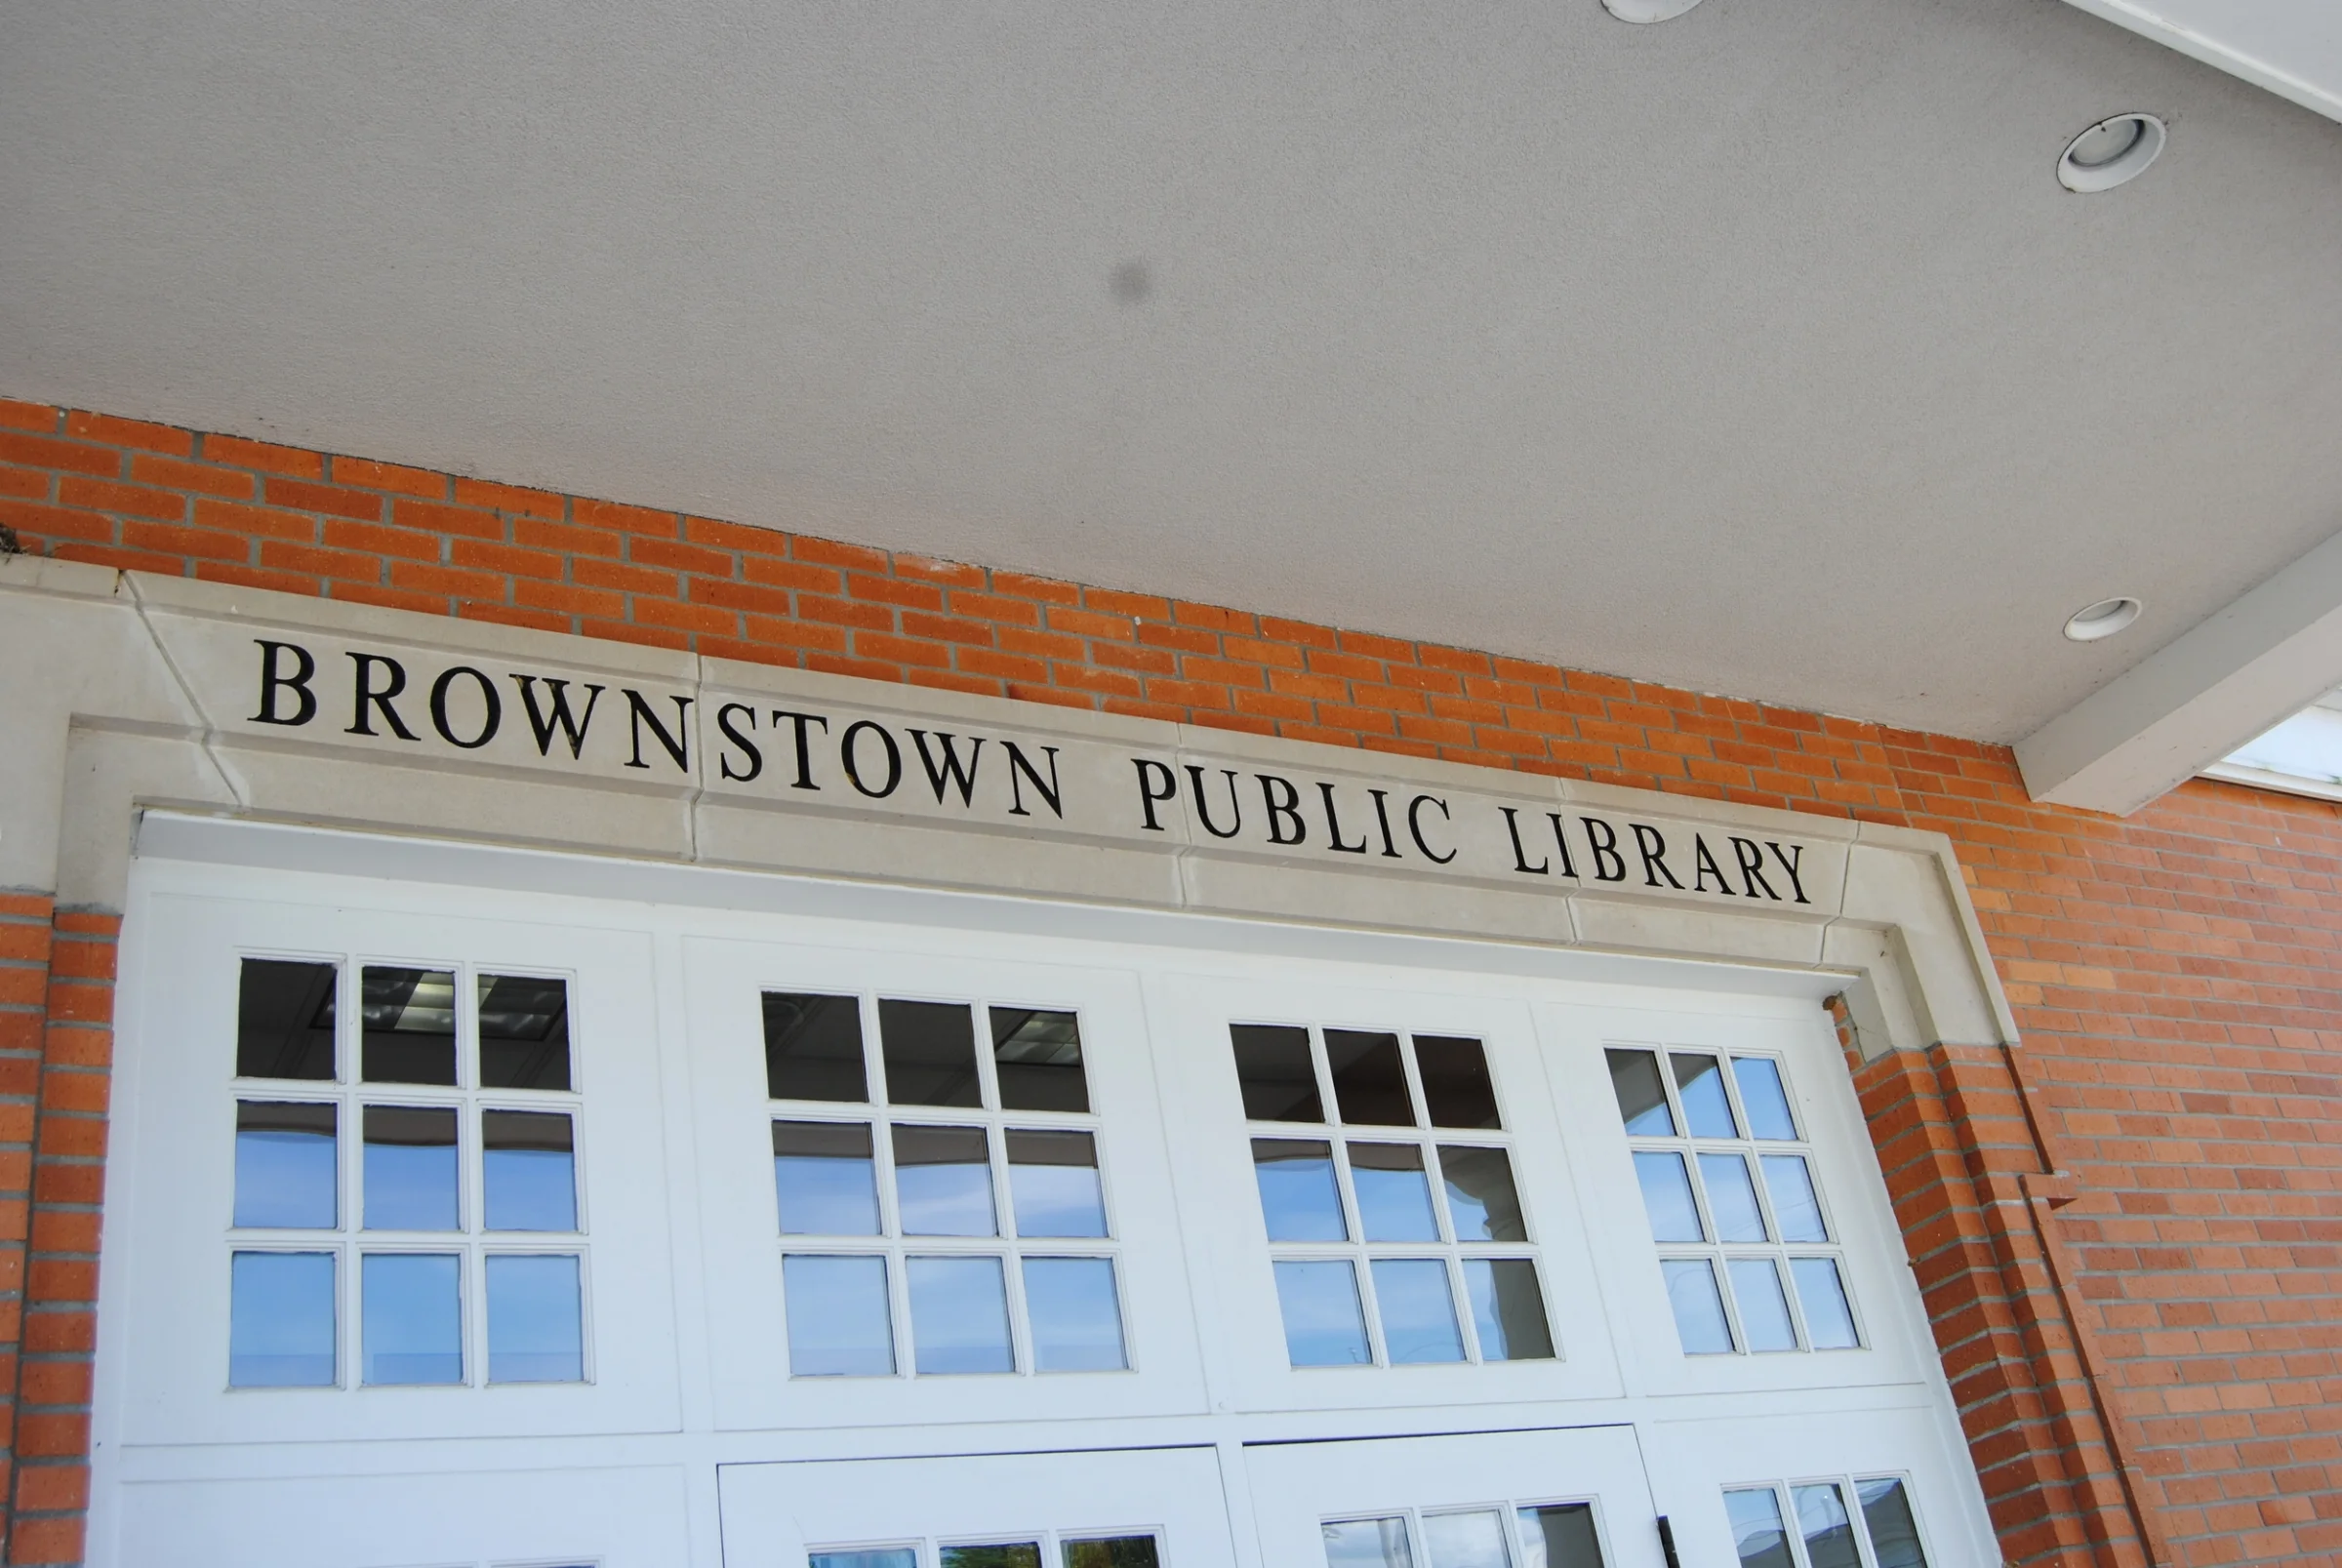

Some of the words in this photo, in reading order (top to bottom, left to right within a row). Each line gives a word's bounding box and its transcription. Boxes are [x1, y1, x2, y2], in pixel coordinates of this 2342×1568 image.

[248, 640, 1063, 820] BROWNSTOWN
[1130, 758, 1457, 864] PUBLIC
[1498, 806, 1811, 905] LIBRARY
